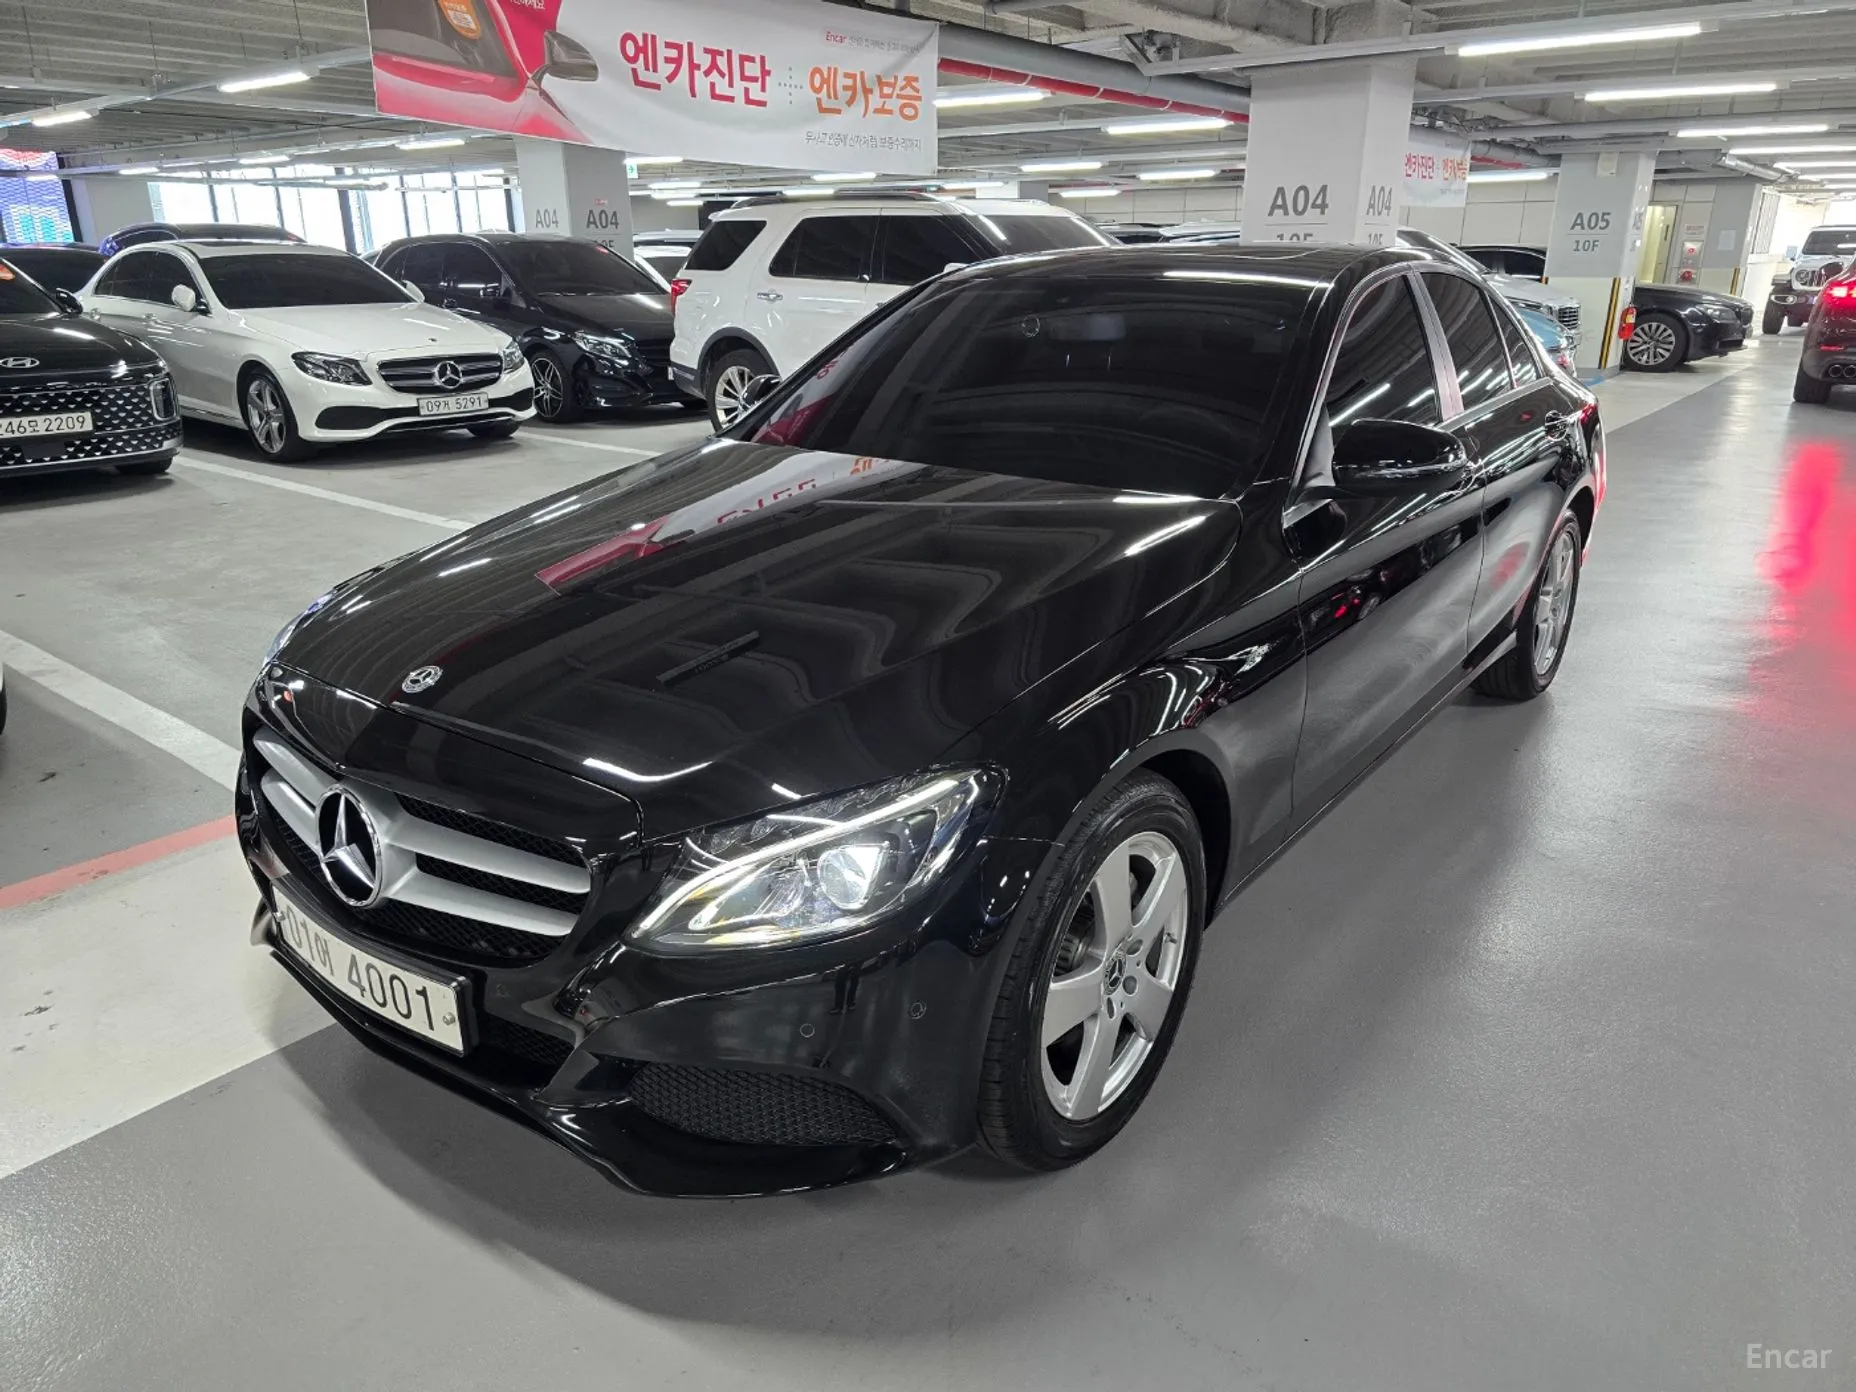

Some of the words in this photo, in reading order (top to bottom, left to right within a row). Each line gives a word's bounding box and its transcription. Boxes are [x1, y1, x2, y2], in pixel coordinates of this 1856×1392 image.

[619, 31, 772, 108] 엔카진단
[808, 65, 923, 122] 엔카보증
[1267, 184, 1329, 217] A04
[1366, 184, 1393, 217] A04
[535, 208, 559, 229] A04
[586, 209, 619, 229] A04
[1570, 211, 1611, 231] A05
[1573, 239, 1600, 252] 10F
[455, 396, 482, 410] 5291
[43, 415, 86, 433] 2209
[347, 953, 435, 1031] 4001
